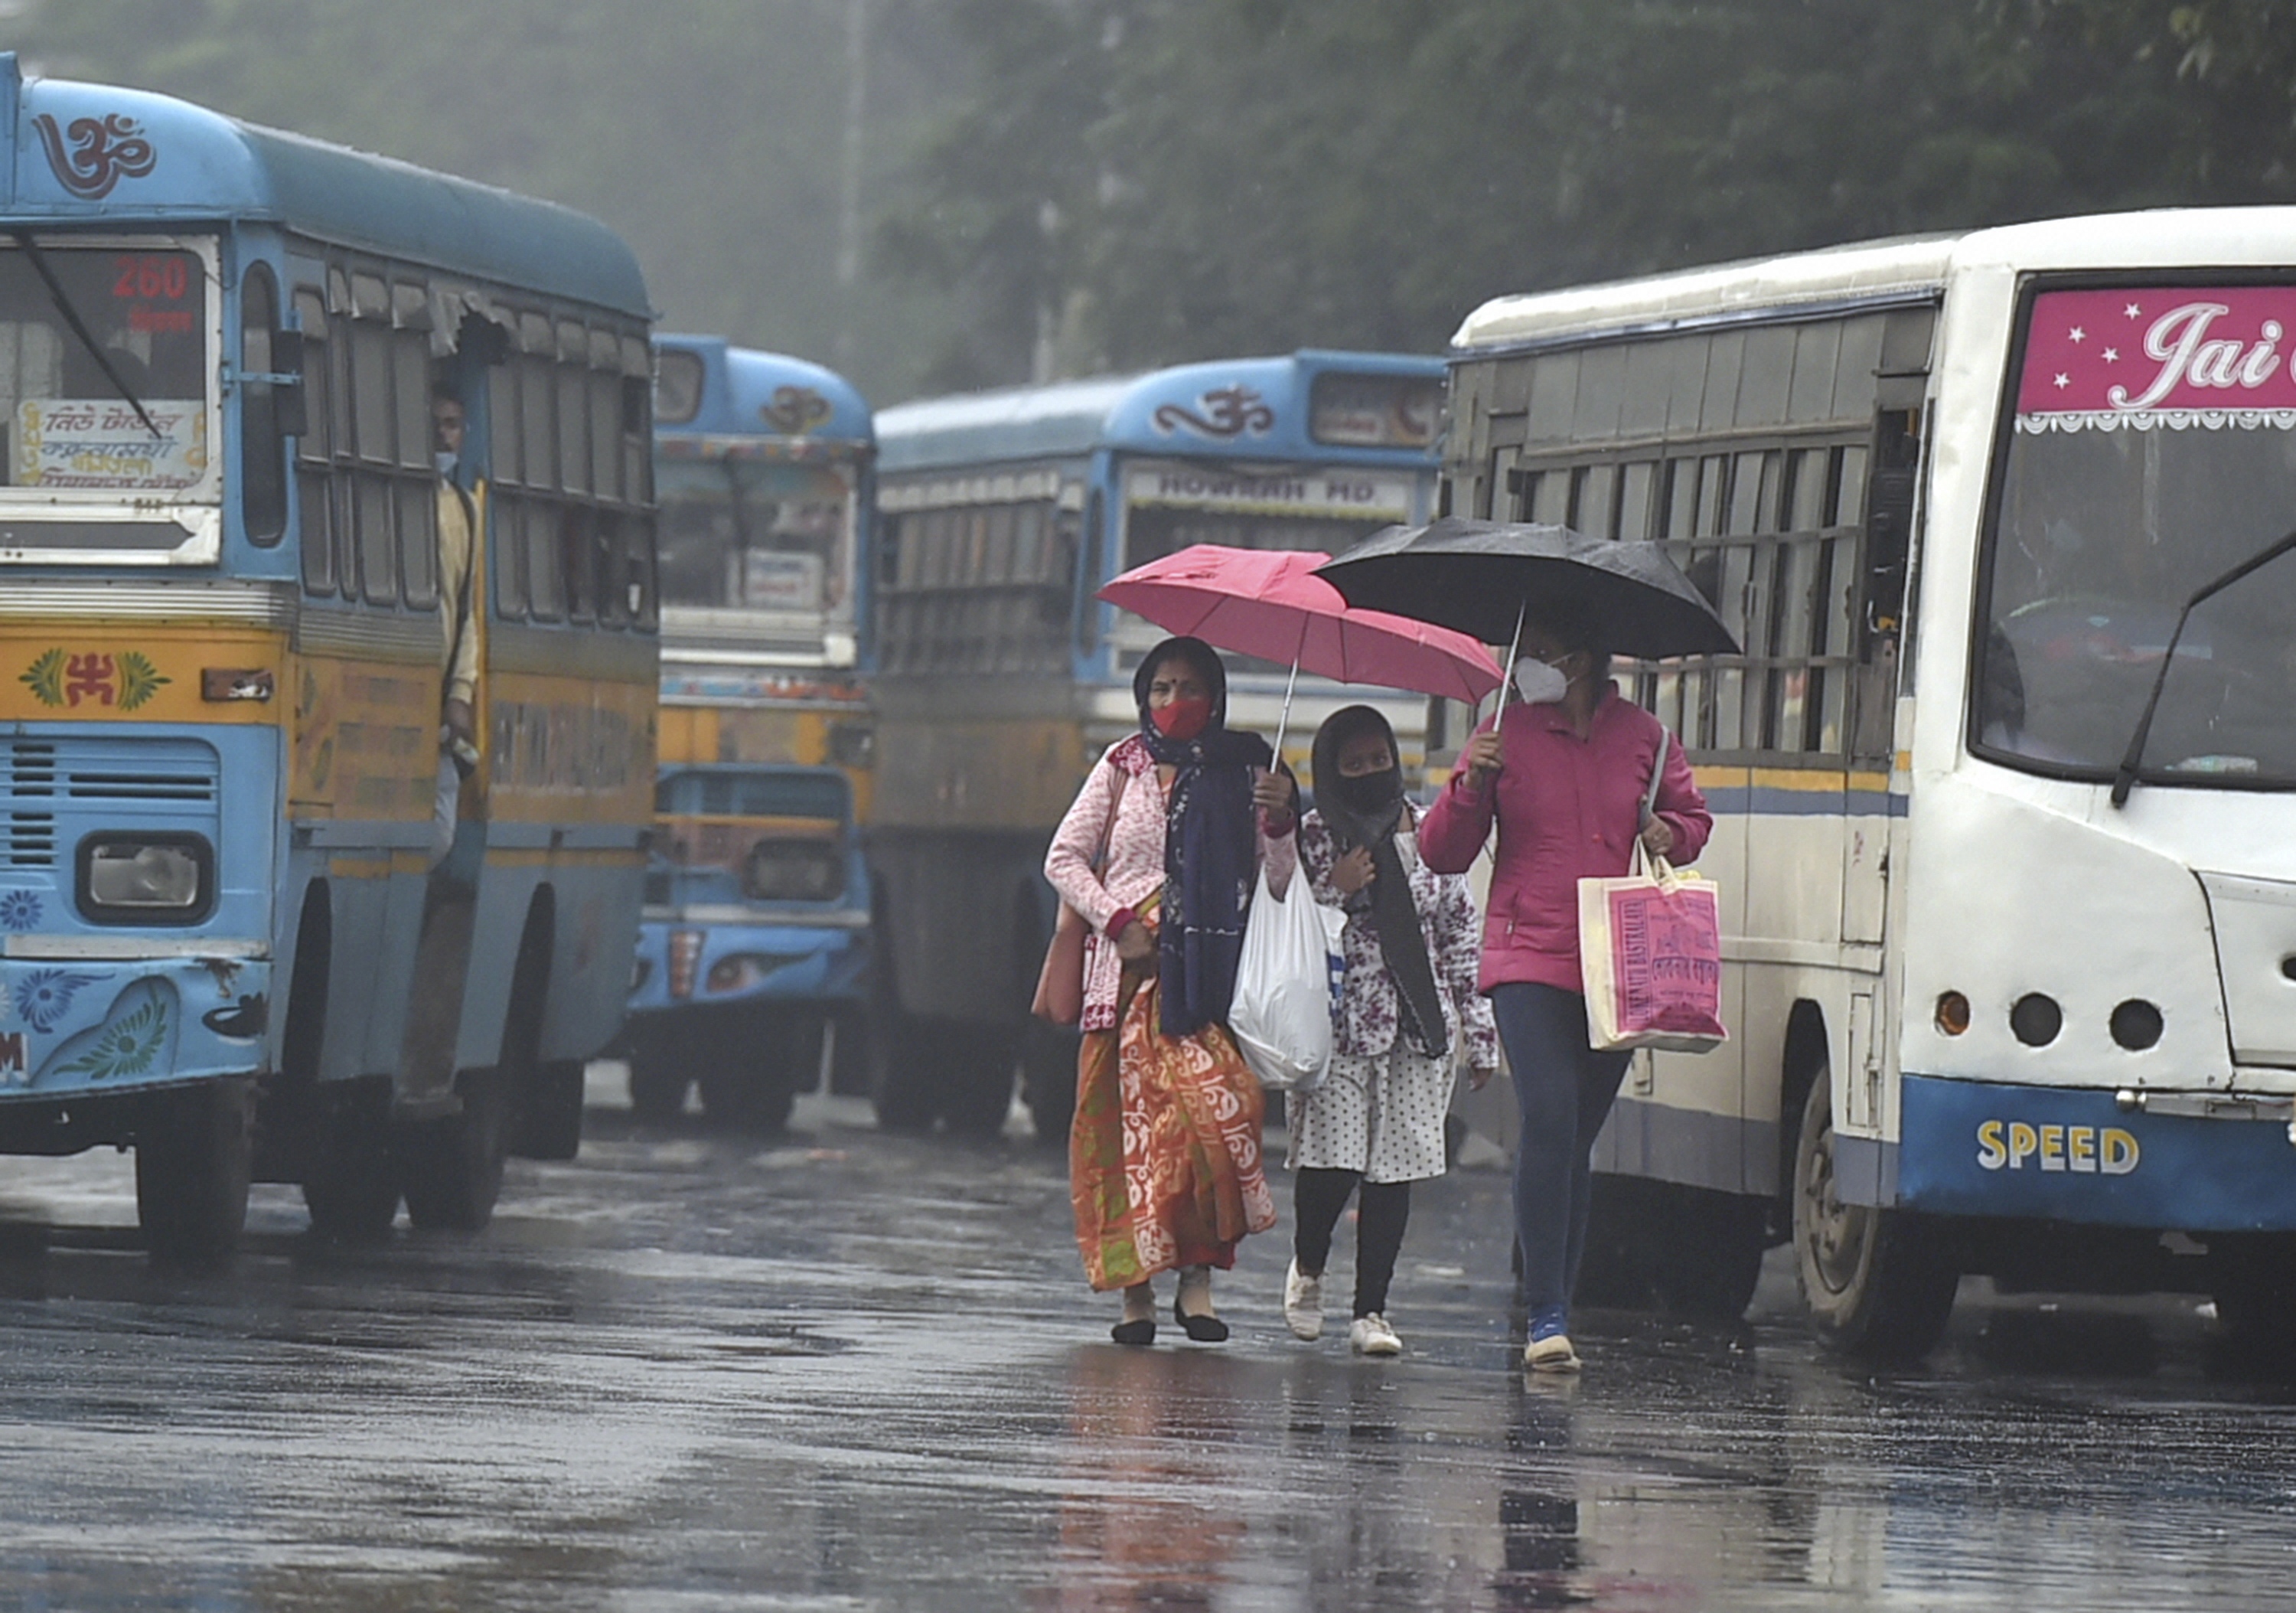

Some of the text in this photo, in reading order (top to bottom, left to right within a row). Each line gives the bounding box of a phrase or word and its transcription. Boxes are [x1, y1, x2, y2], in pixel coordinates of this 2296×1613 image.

[113, 255, 188, 299] 260
[2107, 302, 2281, 410] Jai
[1159, 474, 1306, 500] HOWRAH
[1977, 1120, 2140, 1174] SPEED
